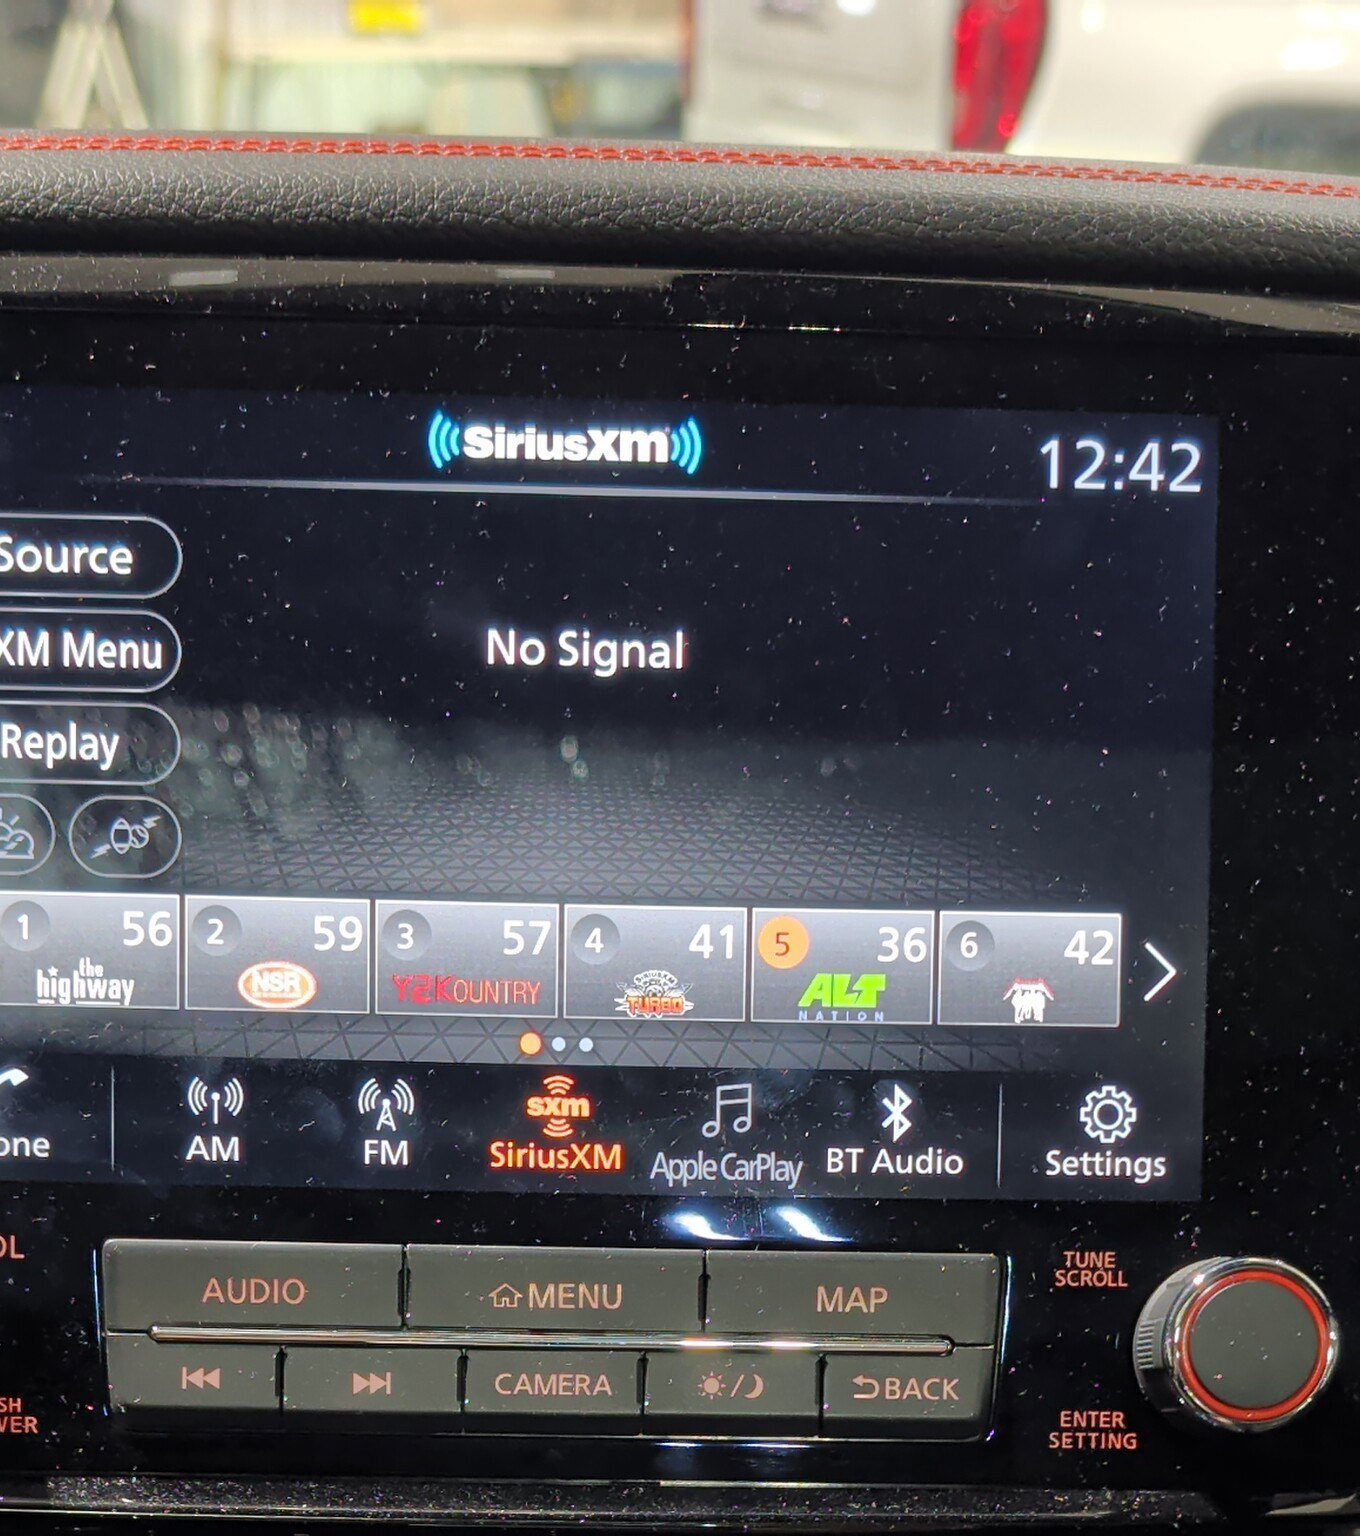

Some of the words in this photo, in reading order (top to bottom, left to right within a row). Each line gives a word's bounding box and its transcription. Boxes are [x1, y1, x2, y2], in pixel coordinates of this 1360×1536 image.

[1040, 438, 1203, 492] 12:42
[61, 630, 164, 670] Menu
[486, 630, 546, 667] No
[557, 629, 686, 678] Signal
[0, 722, 120, 771] Replay
[16, 912, 31, 941] 1
[121, 909, 175, 948] 56
[206, 917, 226, 946] 2
[312, 914, 364, 953] 59
[396, 922, 415, 951] 3
[501, 919, 553, 956] 57
[583, 927, 606, 954] 4
[687, 923, 735, 960] 41
[774, 930, 792, 958] 5
[876, 925, 928, 963] 36
[959, 930, 979, 958] 6
[1062, 929, 1116, 967] 42
[79, 957, 104, 977] the
[37, 966, 135, 1006] highway
[797, 972, 887, 1008] ALT
[626, 995, 685, 1016] TURBO
[798, 1010, 885, 1022] NATION
[185, 1135, 241, 1163] AM
[363, 1138, 410, 1167] FM
[489, 1140, 622, 1171] SiriusXM
[826, 1147, 864, 1175] BT
[871, 1147, 964, 1177] Audio
[650, 1151, 717, 1189] Apple
[719, 1151, 804, 1191] CarPlay
[1045, 1149, 1168, 1185] Settings
[1063, 1251, 1116, 1269] TUNE
[201, 1276, 307, 1306] AUDIO
[1055, 1269, 1128, 1288] SCROLL
[528, 1282, 623, 1312] MENU
[814, 1284, 889, 1316] MAP
[495, 1373, 611, 1398] CAMERA
[885, 1374, 959, 1402] BACK
[1059, 1410, 1126, 1430] ENTER
[1048, 1431, 1138, 1451] SETTING
